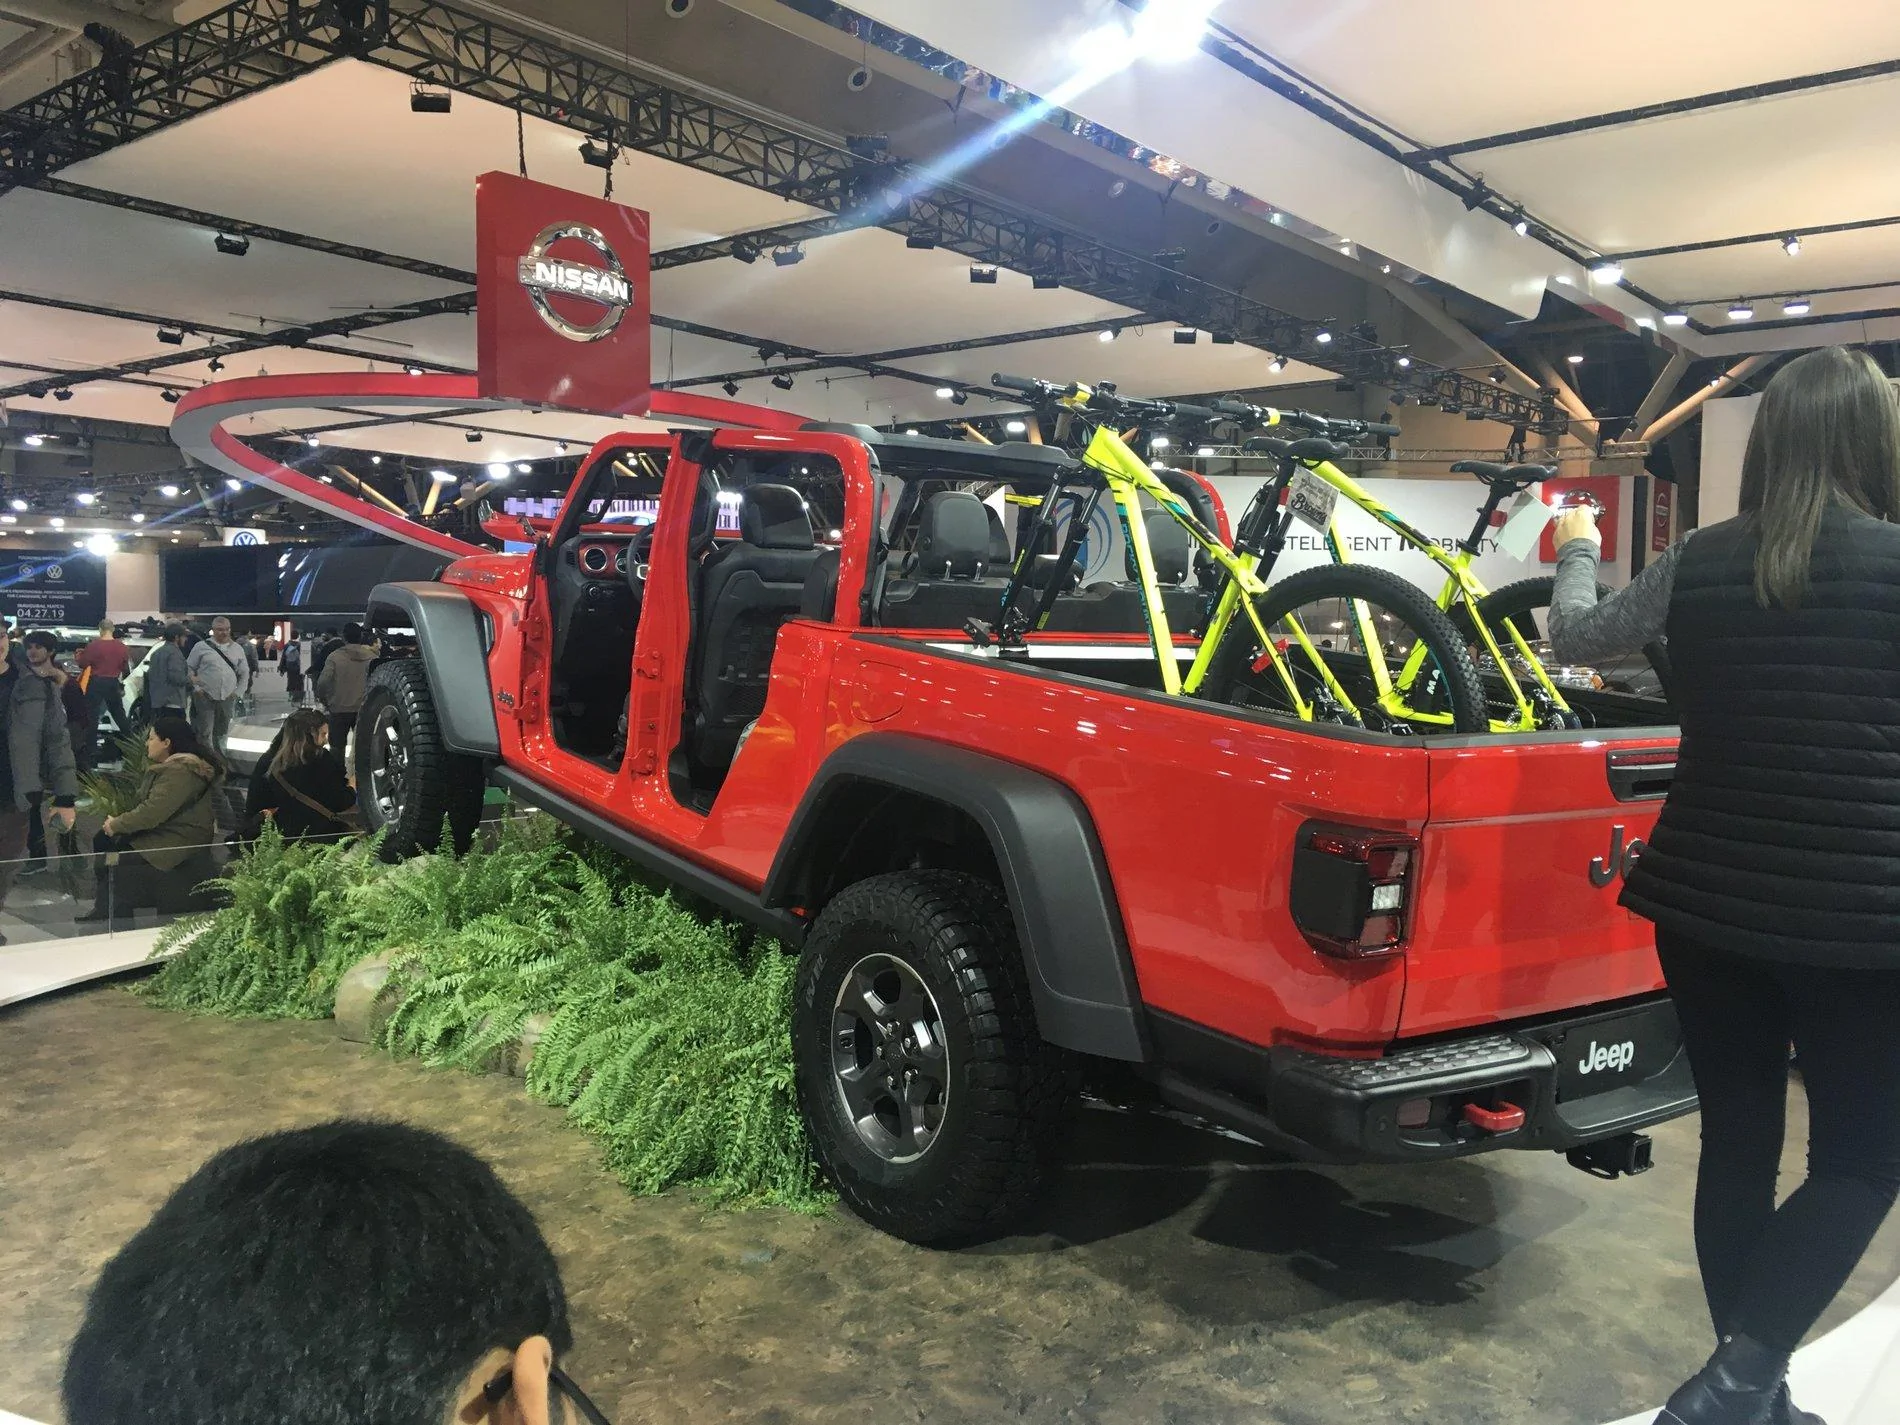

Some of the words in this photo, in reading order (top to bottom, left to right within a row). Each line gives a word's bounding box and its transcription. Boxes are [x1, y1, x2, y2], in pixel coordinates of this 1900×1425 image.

[535, 262, 629, 300] NISSAN
[17, 608, 65, 618] 04.27.19
[1579, 1041, 1634, 1075] Jeep
